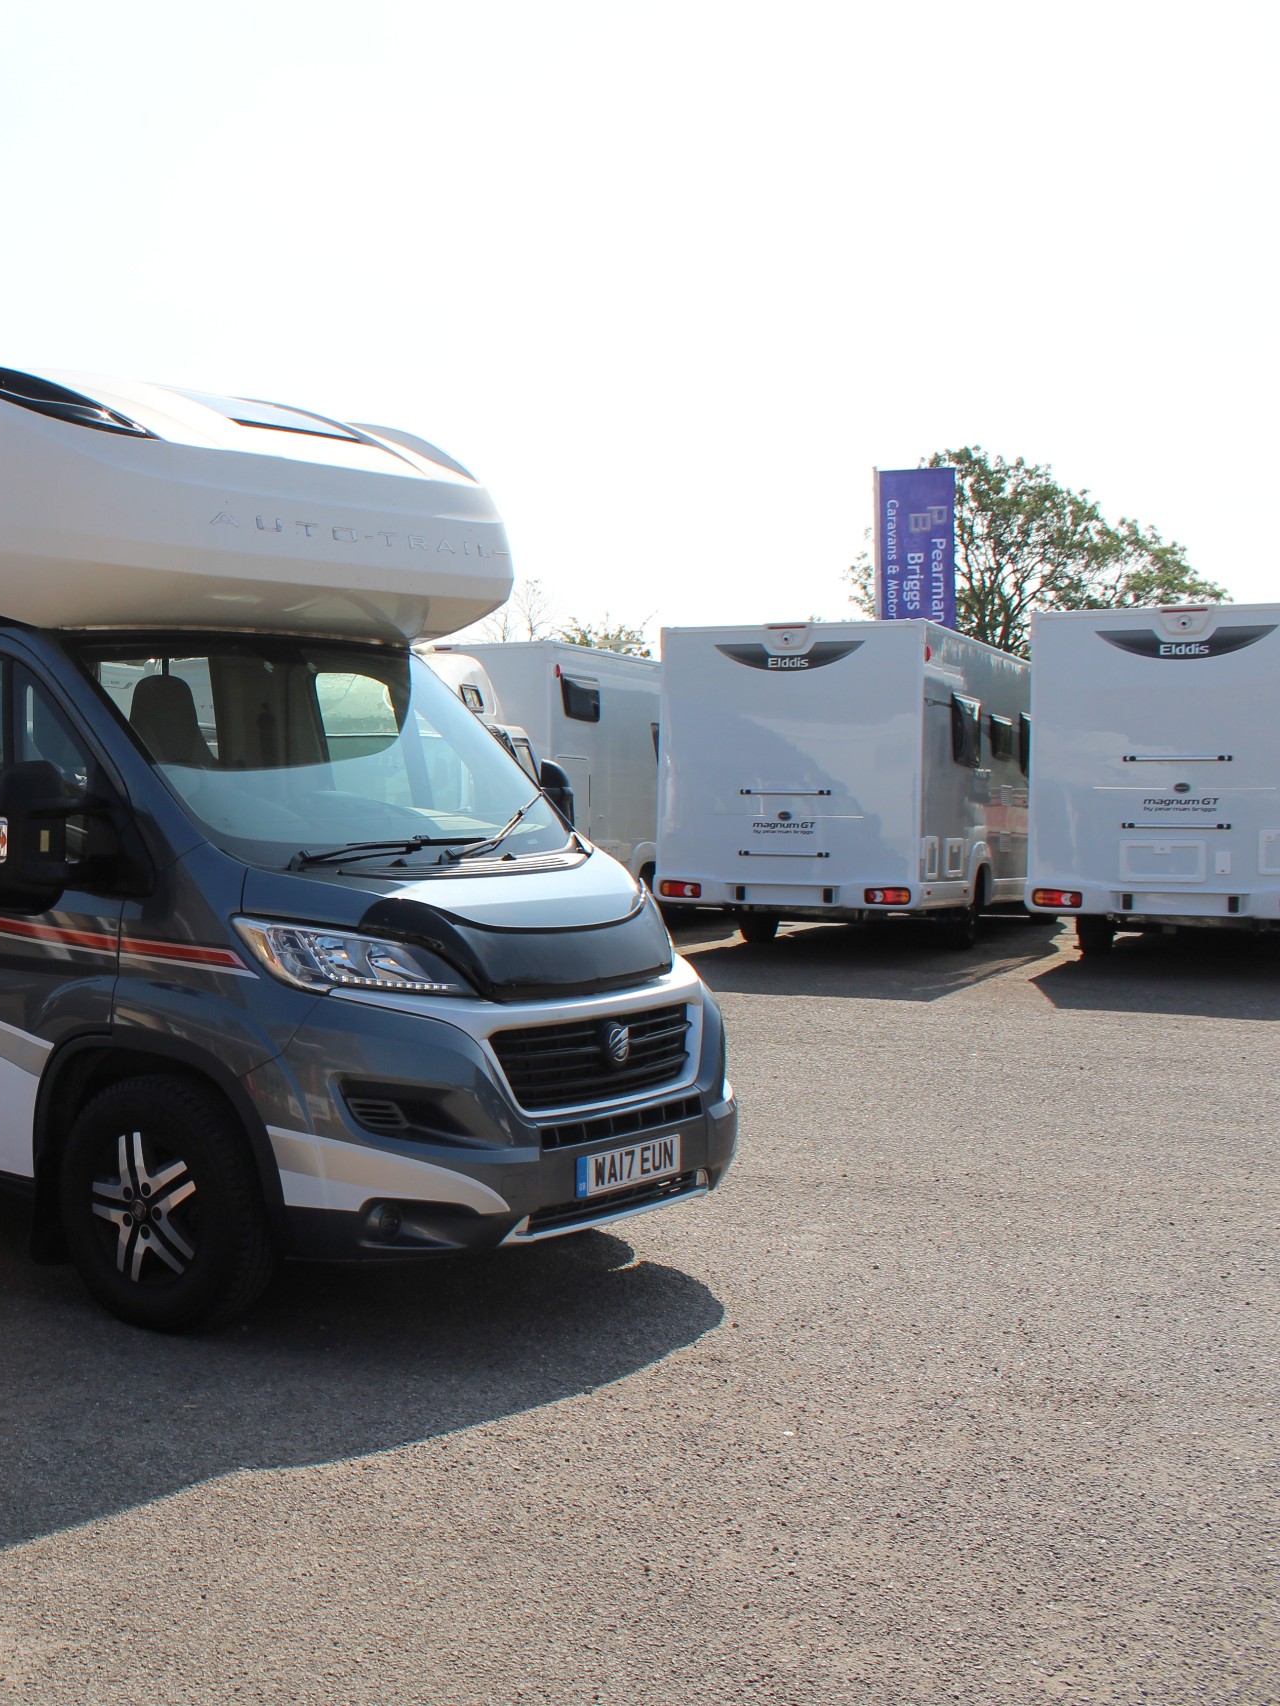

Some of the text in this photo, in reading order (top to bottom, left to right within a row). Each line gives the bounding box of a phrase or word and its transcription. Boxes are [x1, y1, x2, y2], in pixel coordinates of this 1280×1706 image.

[209, 511, 492, 558] AUTO-TRAIL
[886, 499, 899, 561] Caravans
[887, 565, 899, 575] &
[903, 552, 924, 611] Briggs
[931, 538, 947, 623] Pearman
[767, 657, 809, 668] Elddis
[1160, 643, 1210, 656] Elddis
[1143, 797, 1220, 807] magnum GT
[752, 821, 816, 829] magnum GT
[594, 1139, 674, 1187] WA17 EUN
